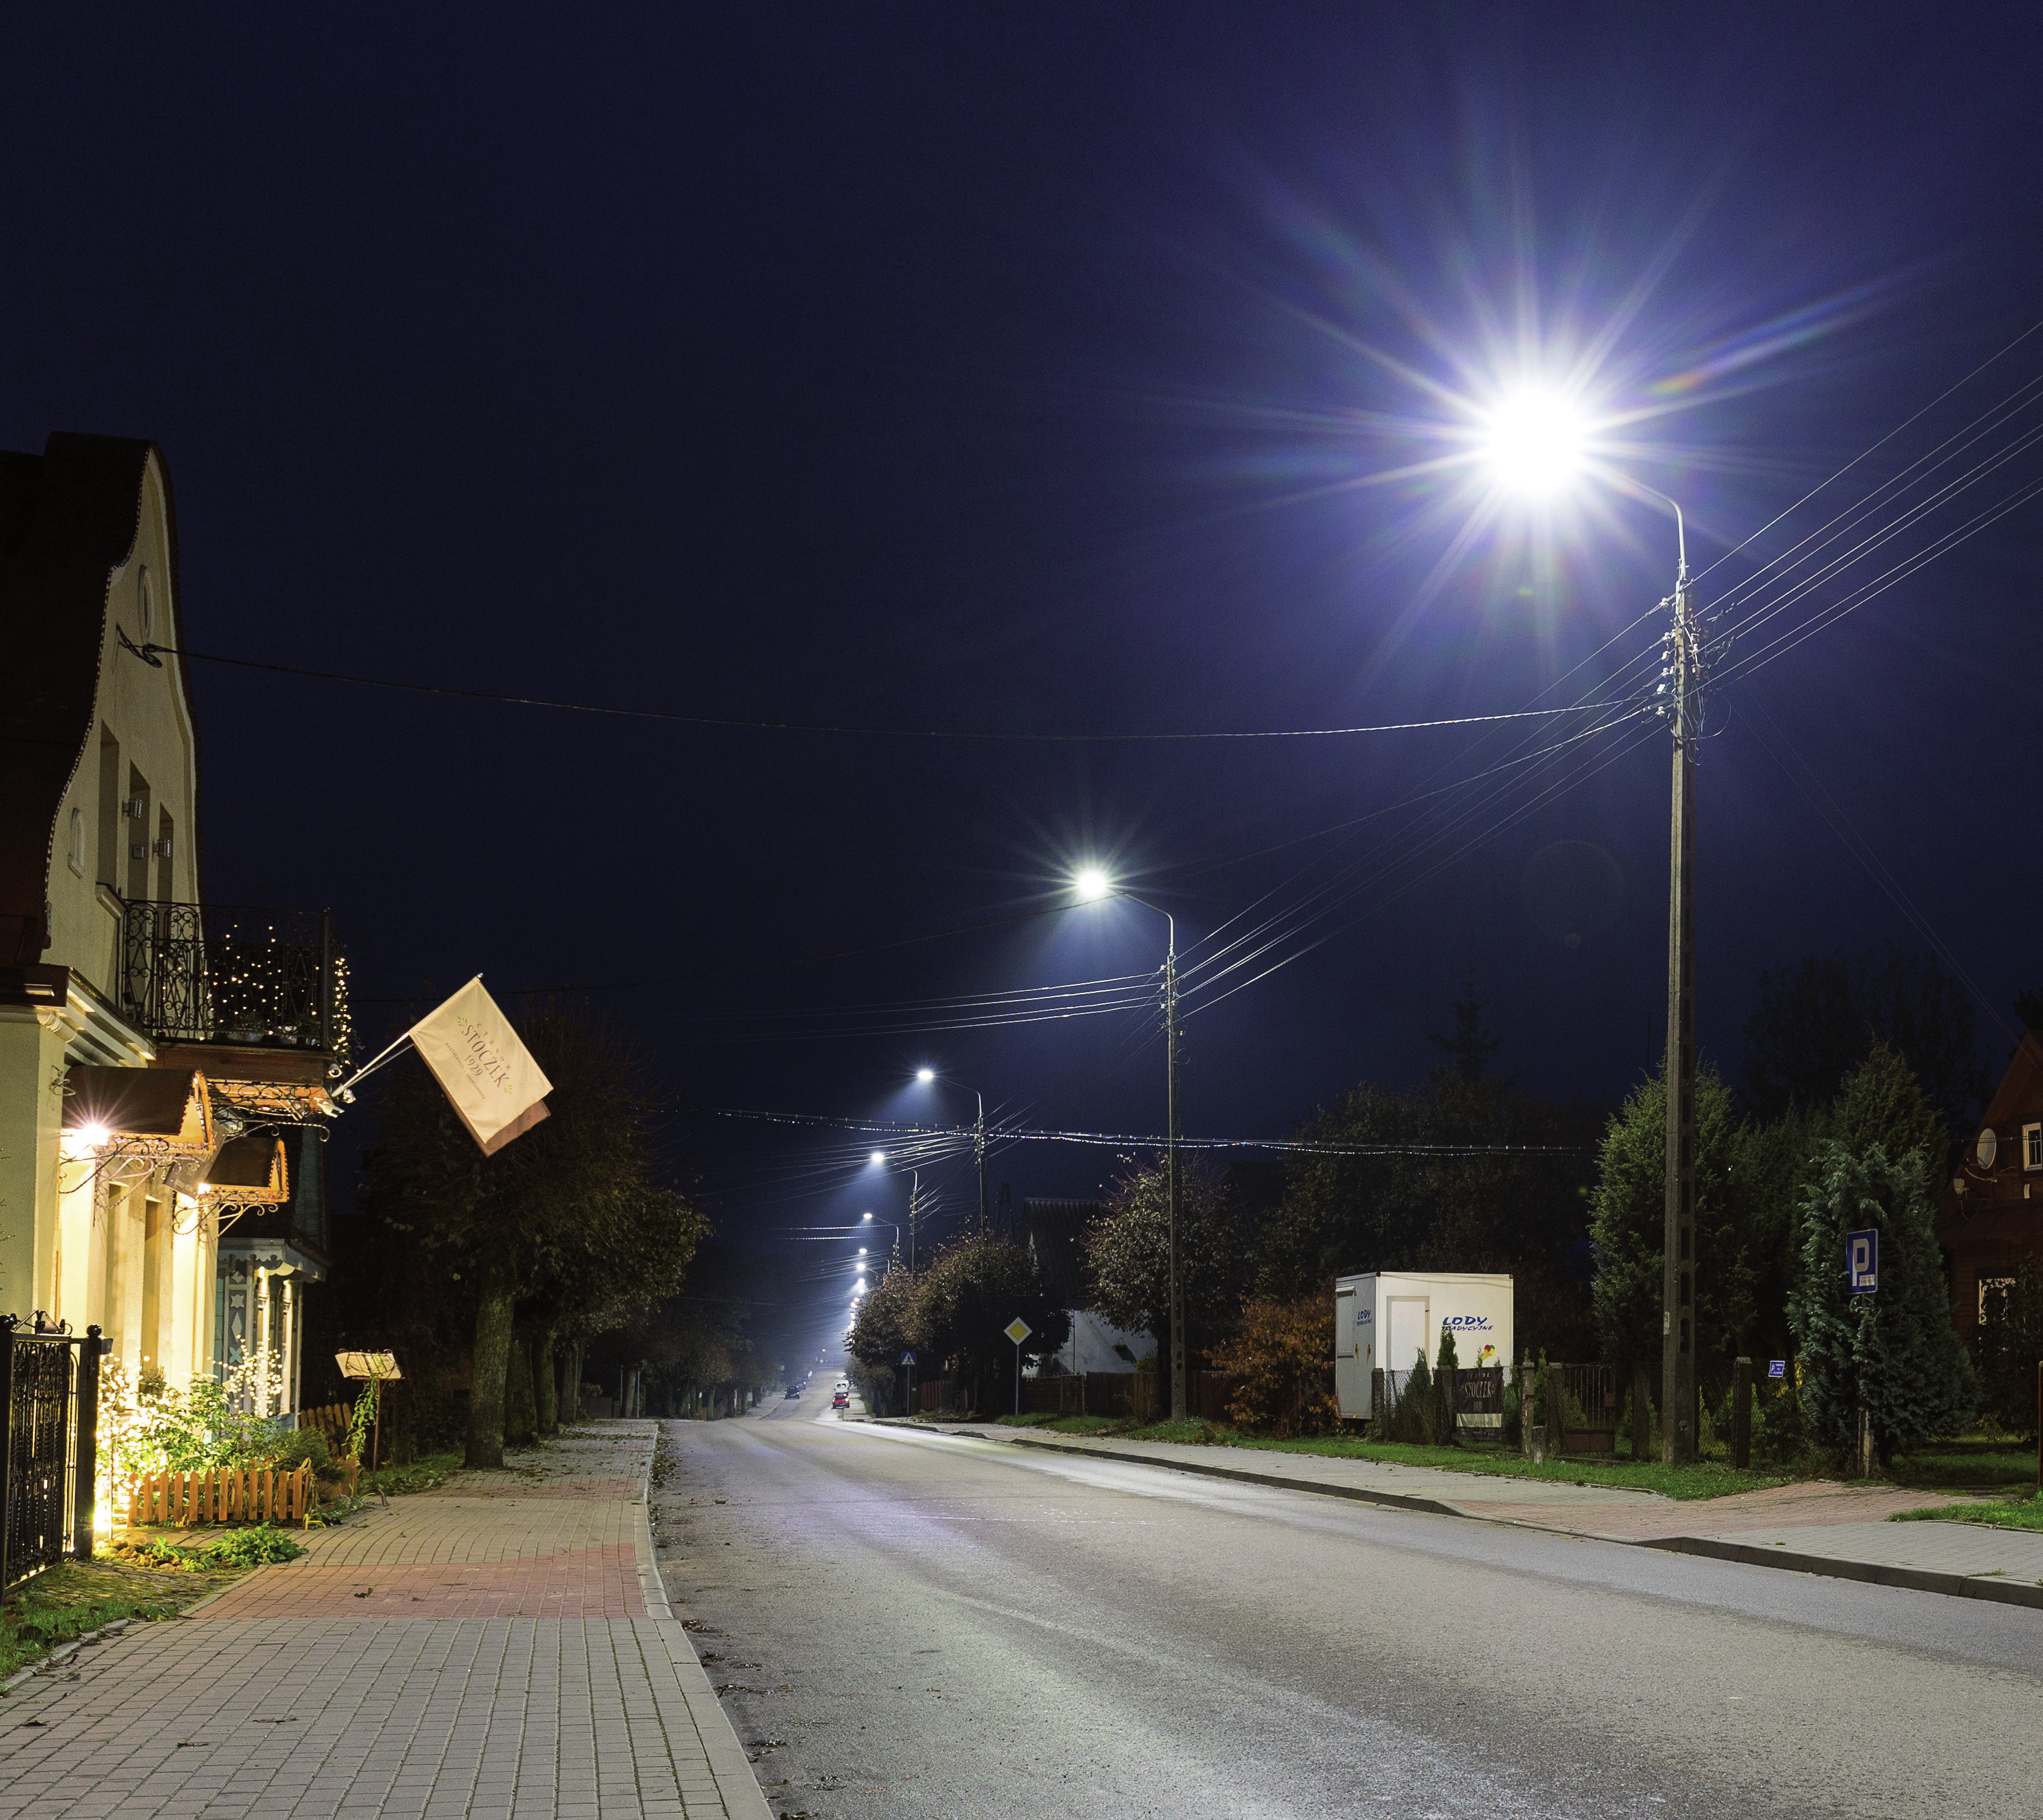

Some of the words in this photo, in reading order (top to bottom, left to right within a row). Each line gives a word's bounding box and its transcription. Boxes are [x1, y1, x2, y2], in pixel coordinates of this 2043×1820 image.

[461, 1024, 510, 1088] STOCZEK
[465, 1054, 483, 1076] 1929
[1852, 1238, 1869, 1286] P
[1357, 1309, 1371, 1320] LODY
[1442, 1316, 1487, 1326] LODY
[1465, 1381, 1492, 1398] STOCZEK
